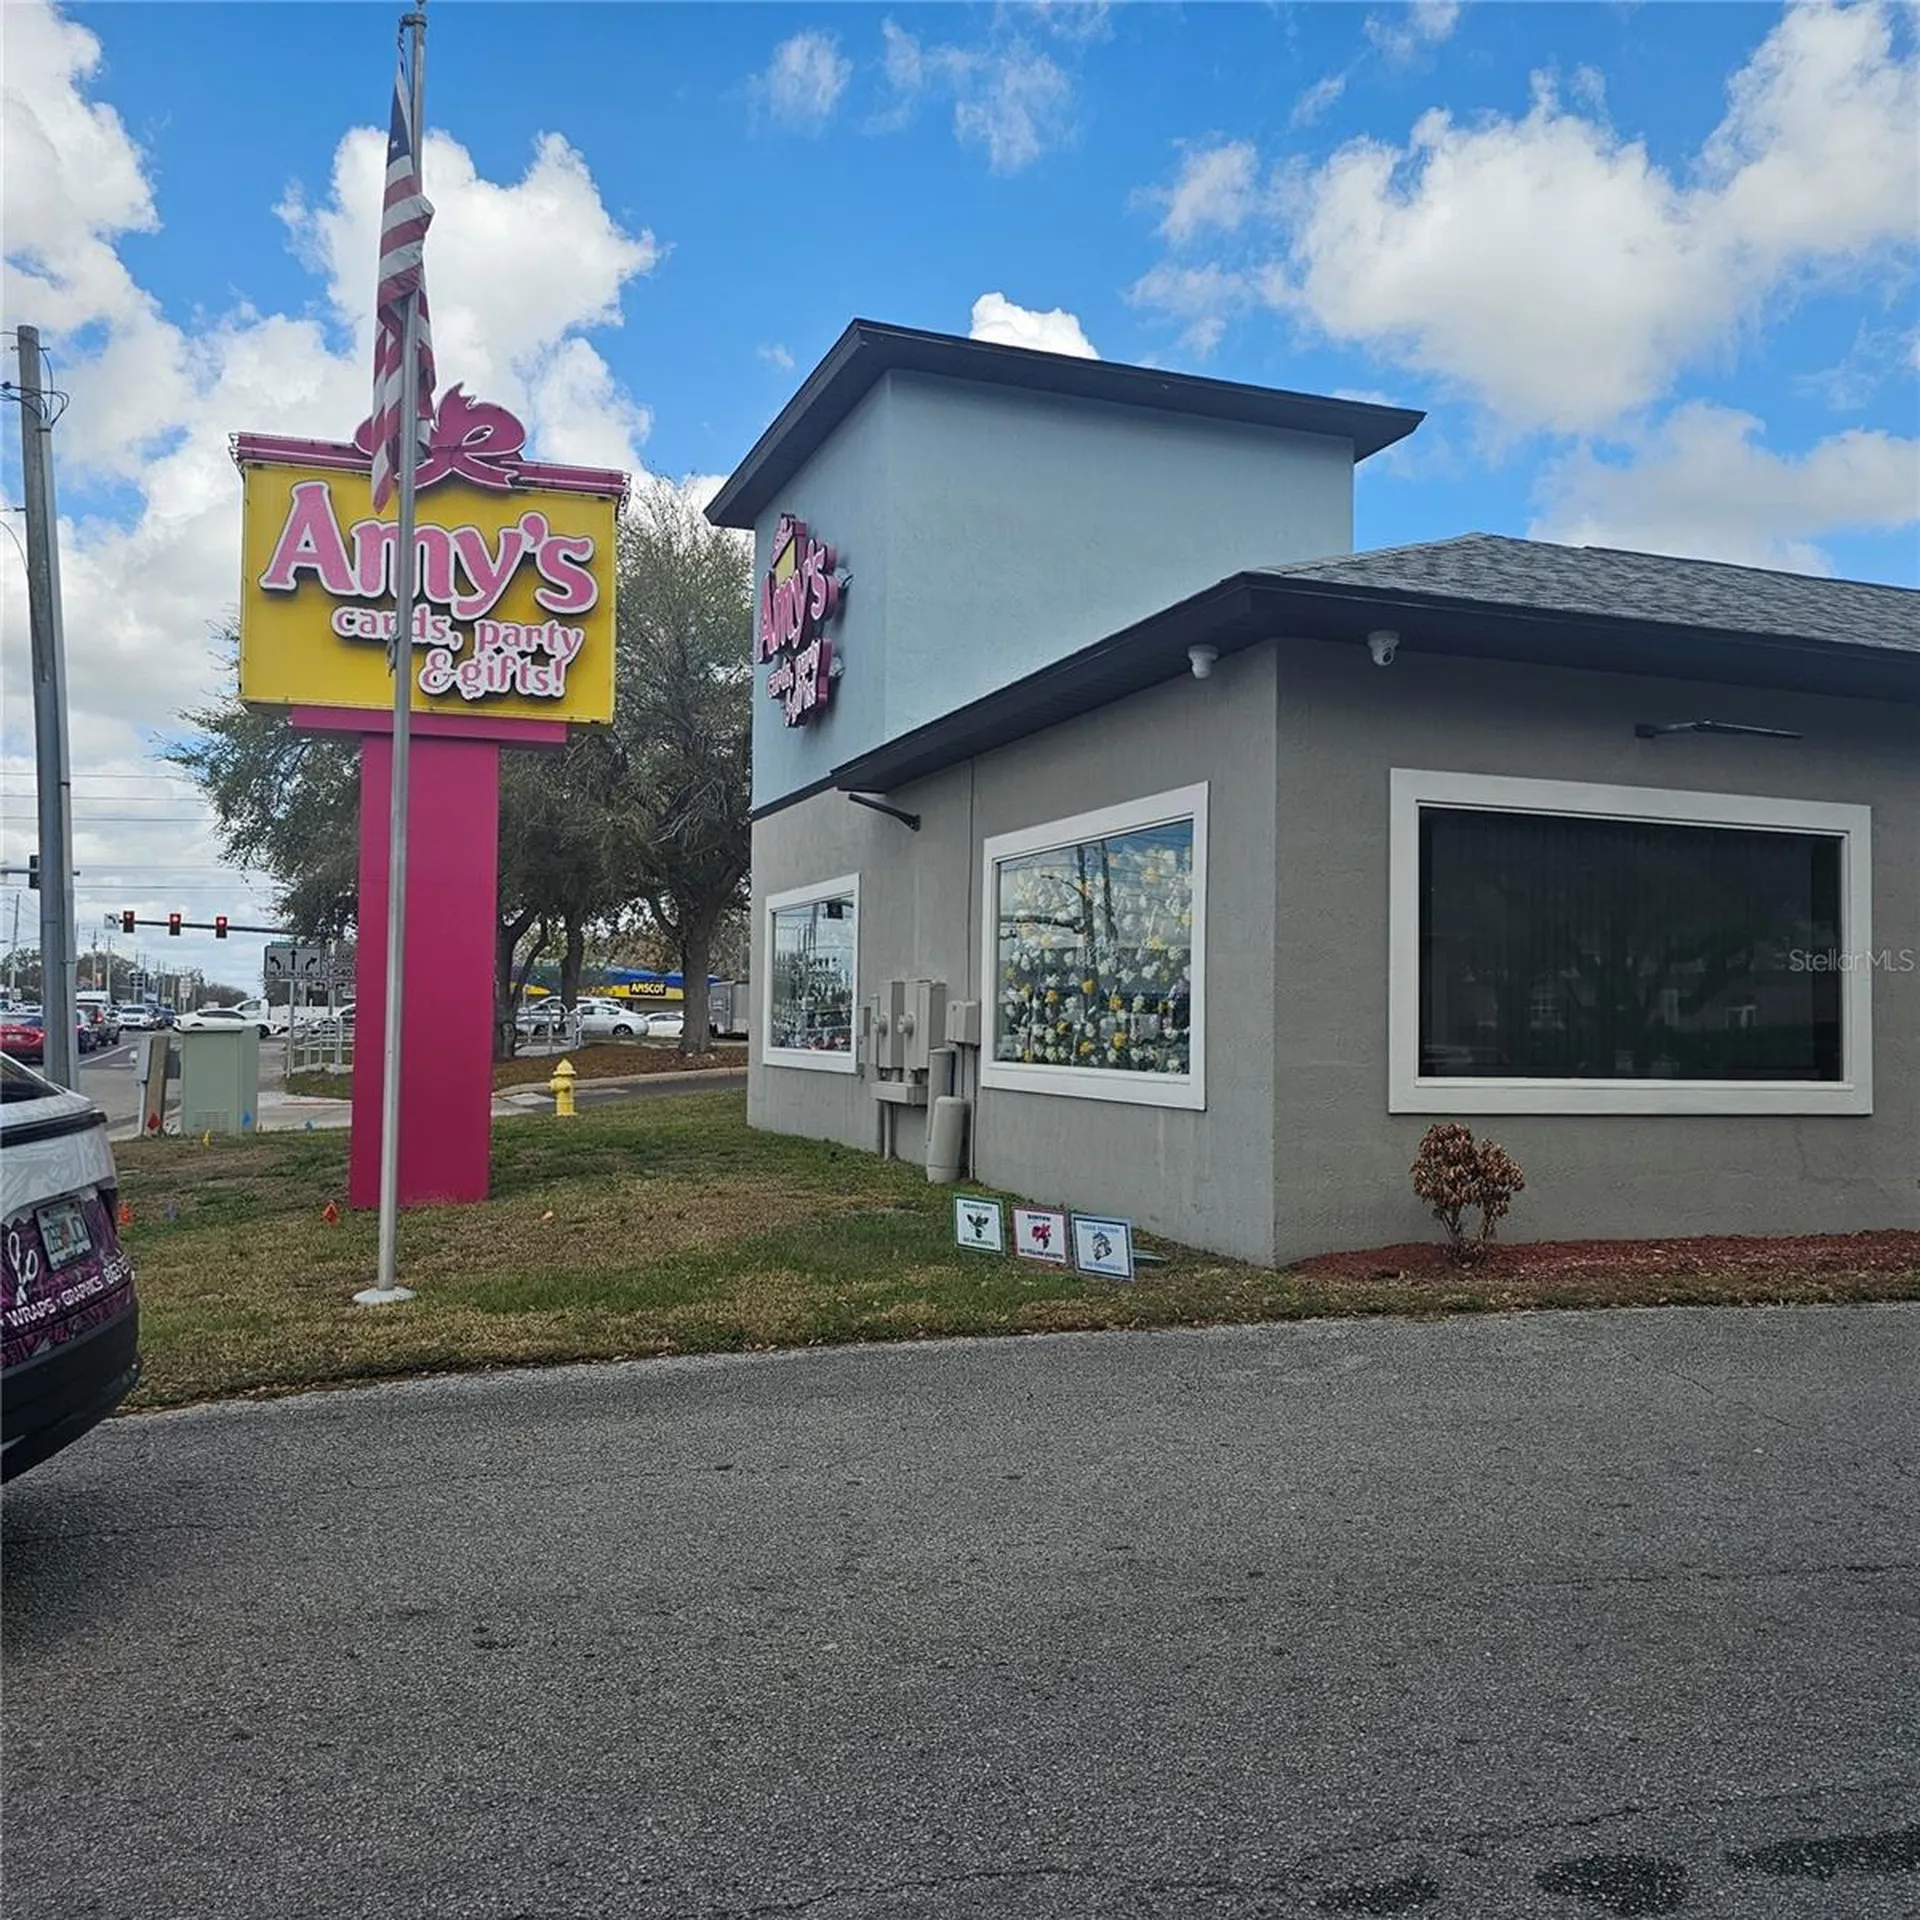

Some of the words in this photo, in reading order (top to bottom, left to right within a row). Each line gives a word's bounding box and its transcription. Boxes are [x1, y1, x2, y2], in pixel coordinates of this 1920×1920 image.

[258, 481, 599, 620] Amy's
[758, 538, 827, 664] Amy's
[475, 620, 584, 661] party
[631, 982, 665, 994] AMSCOT
[5, 1297, 57, 1327] WRAPS
[61, 1275, 104, 1306] GRAPHICS
